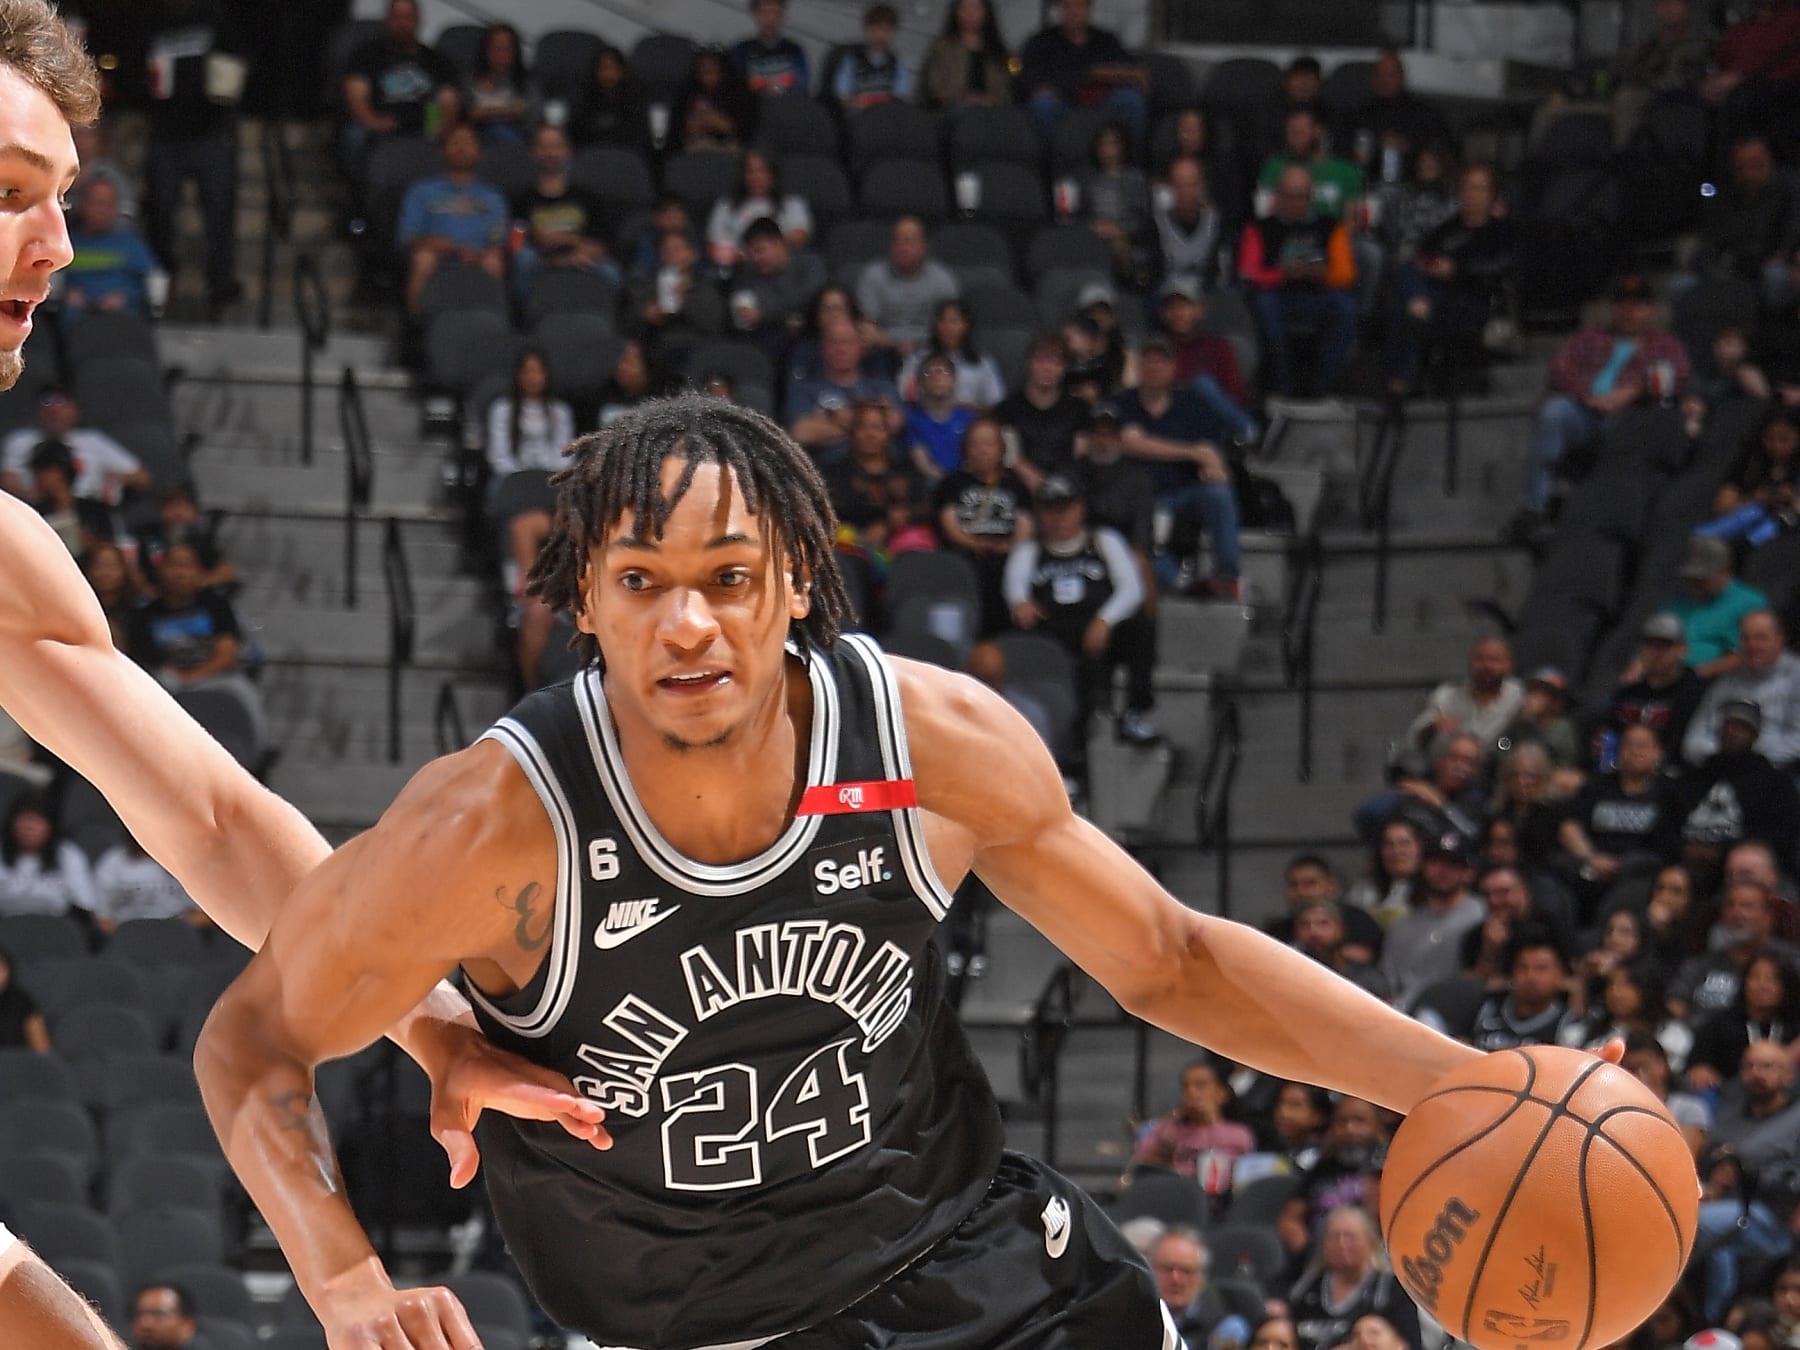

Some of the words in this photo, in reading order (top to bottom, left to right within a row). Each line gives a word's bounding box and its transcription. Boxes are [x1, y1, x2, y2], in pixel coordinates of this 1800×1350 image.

[588, 838, 620, 881] 6
[605, 898, 660, 930] NIKE
[573, 993, 689, 1118] SAN
[661, 1037, 872, 1191] 24
